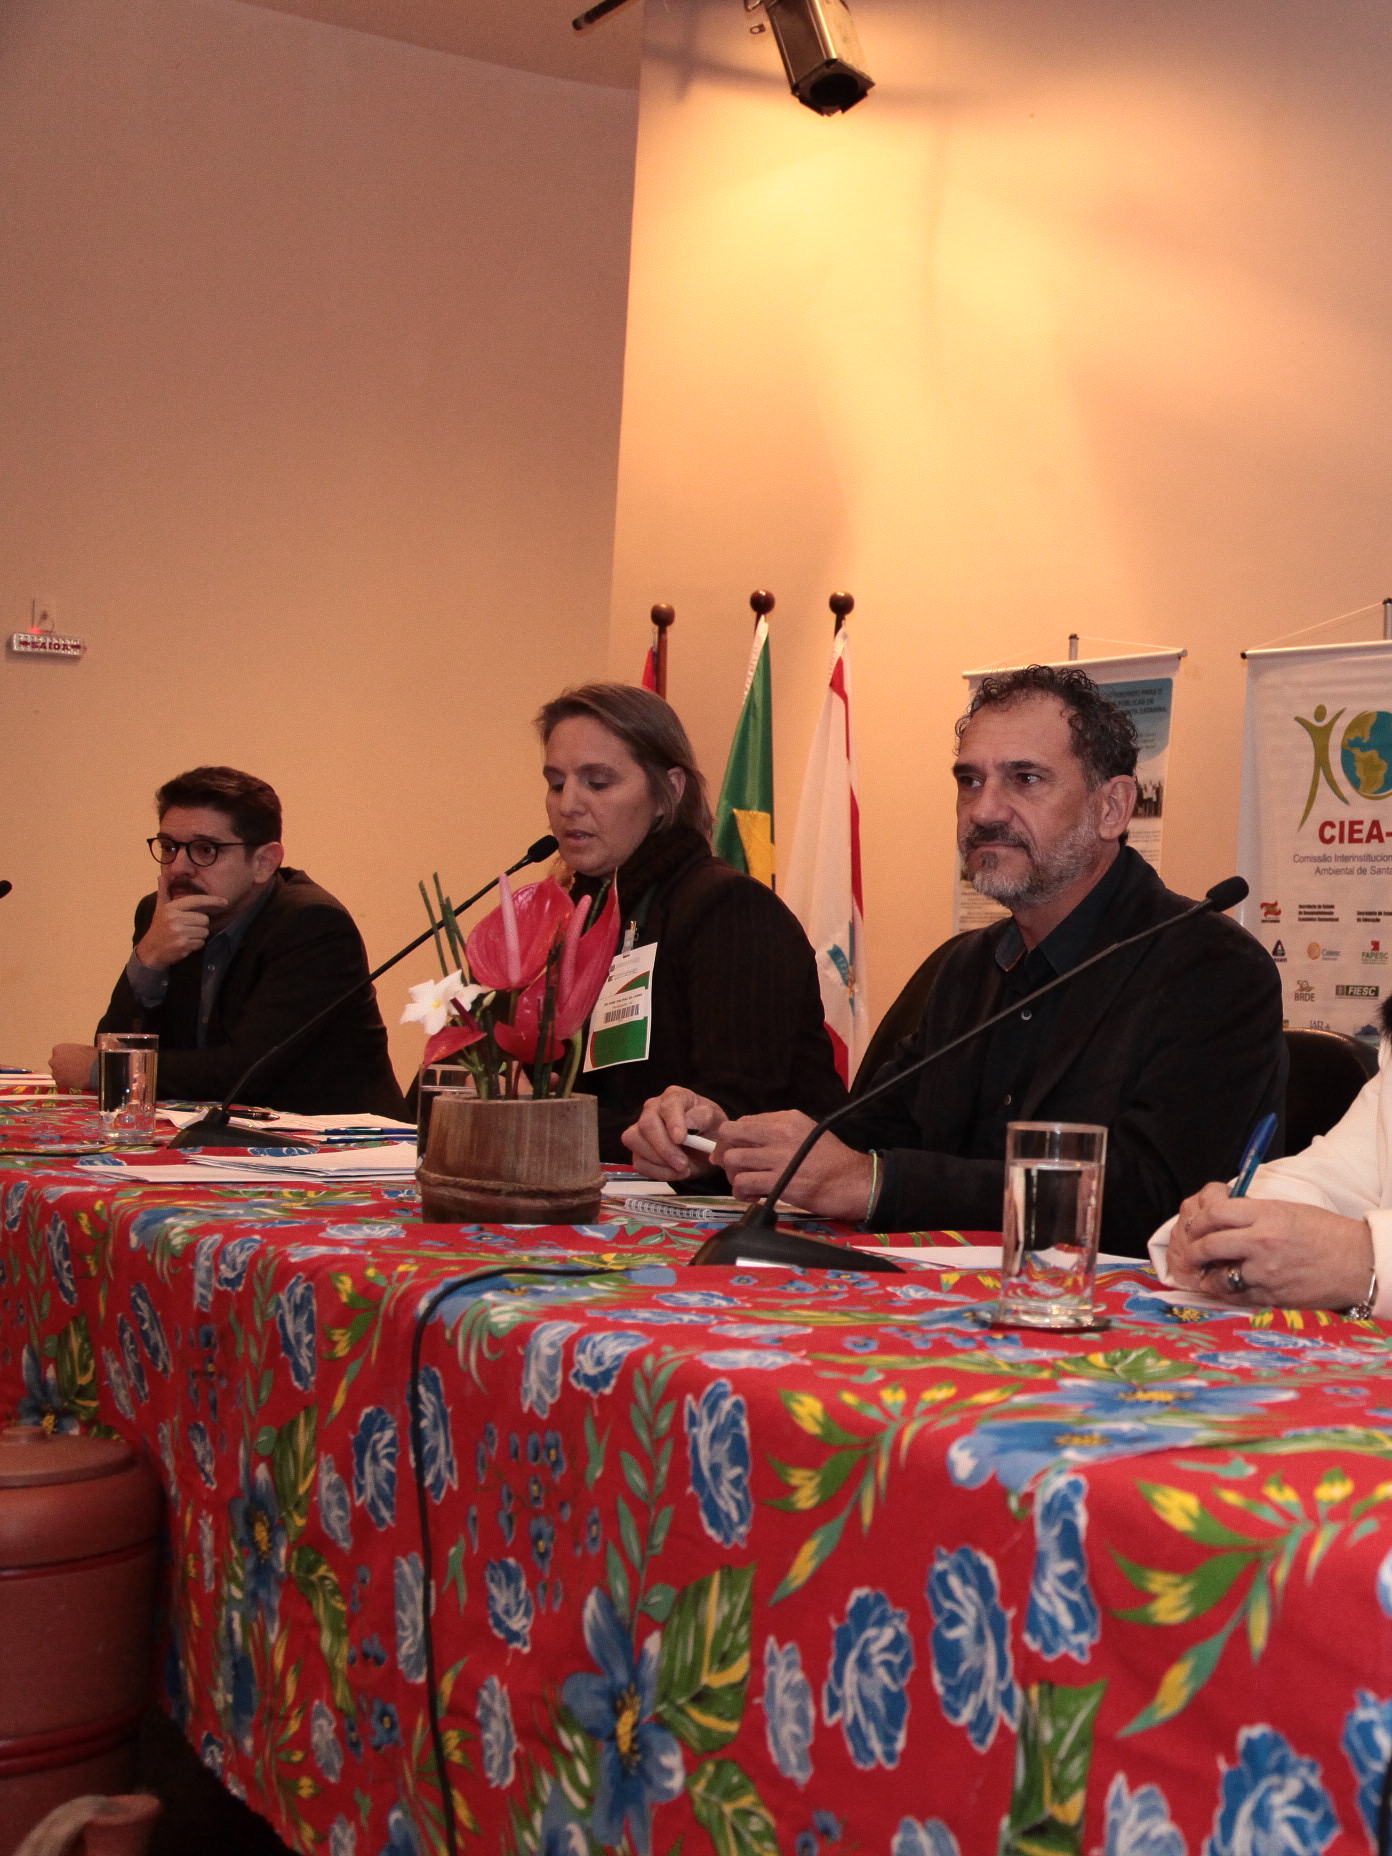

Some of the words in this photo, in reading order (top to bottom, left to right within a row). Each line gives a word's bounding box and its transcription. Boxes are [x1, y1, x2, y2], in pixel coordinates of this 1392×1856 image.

[1293, 854, 1333, 863] Comissão
[1315, 866, 1354, 875] Ambiental
[1356, 866, 1367, 875] de
[1348, 986, 1377, 996] FIESC
[1294, 992, 1316, 1002] BRDE
